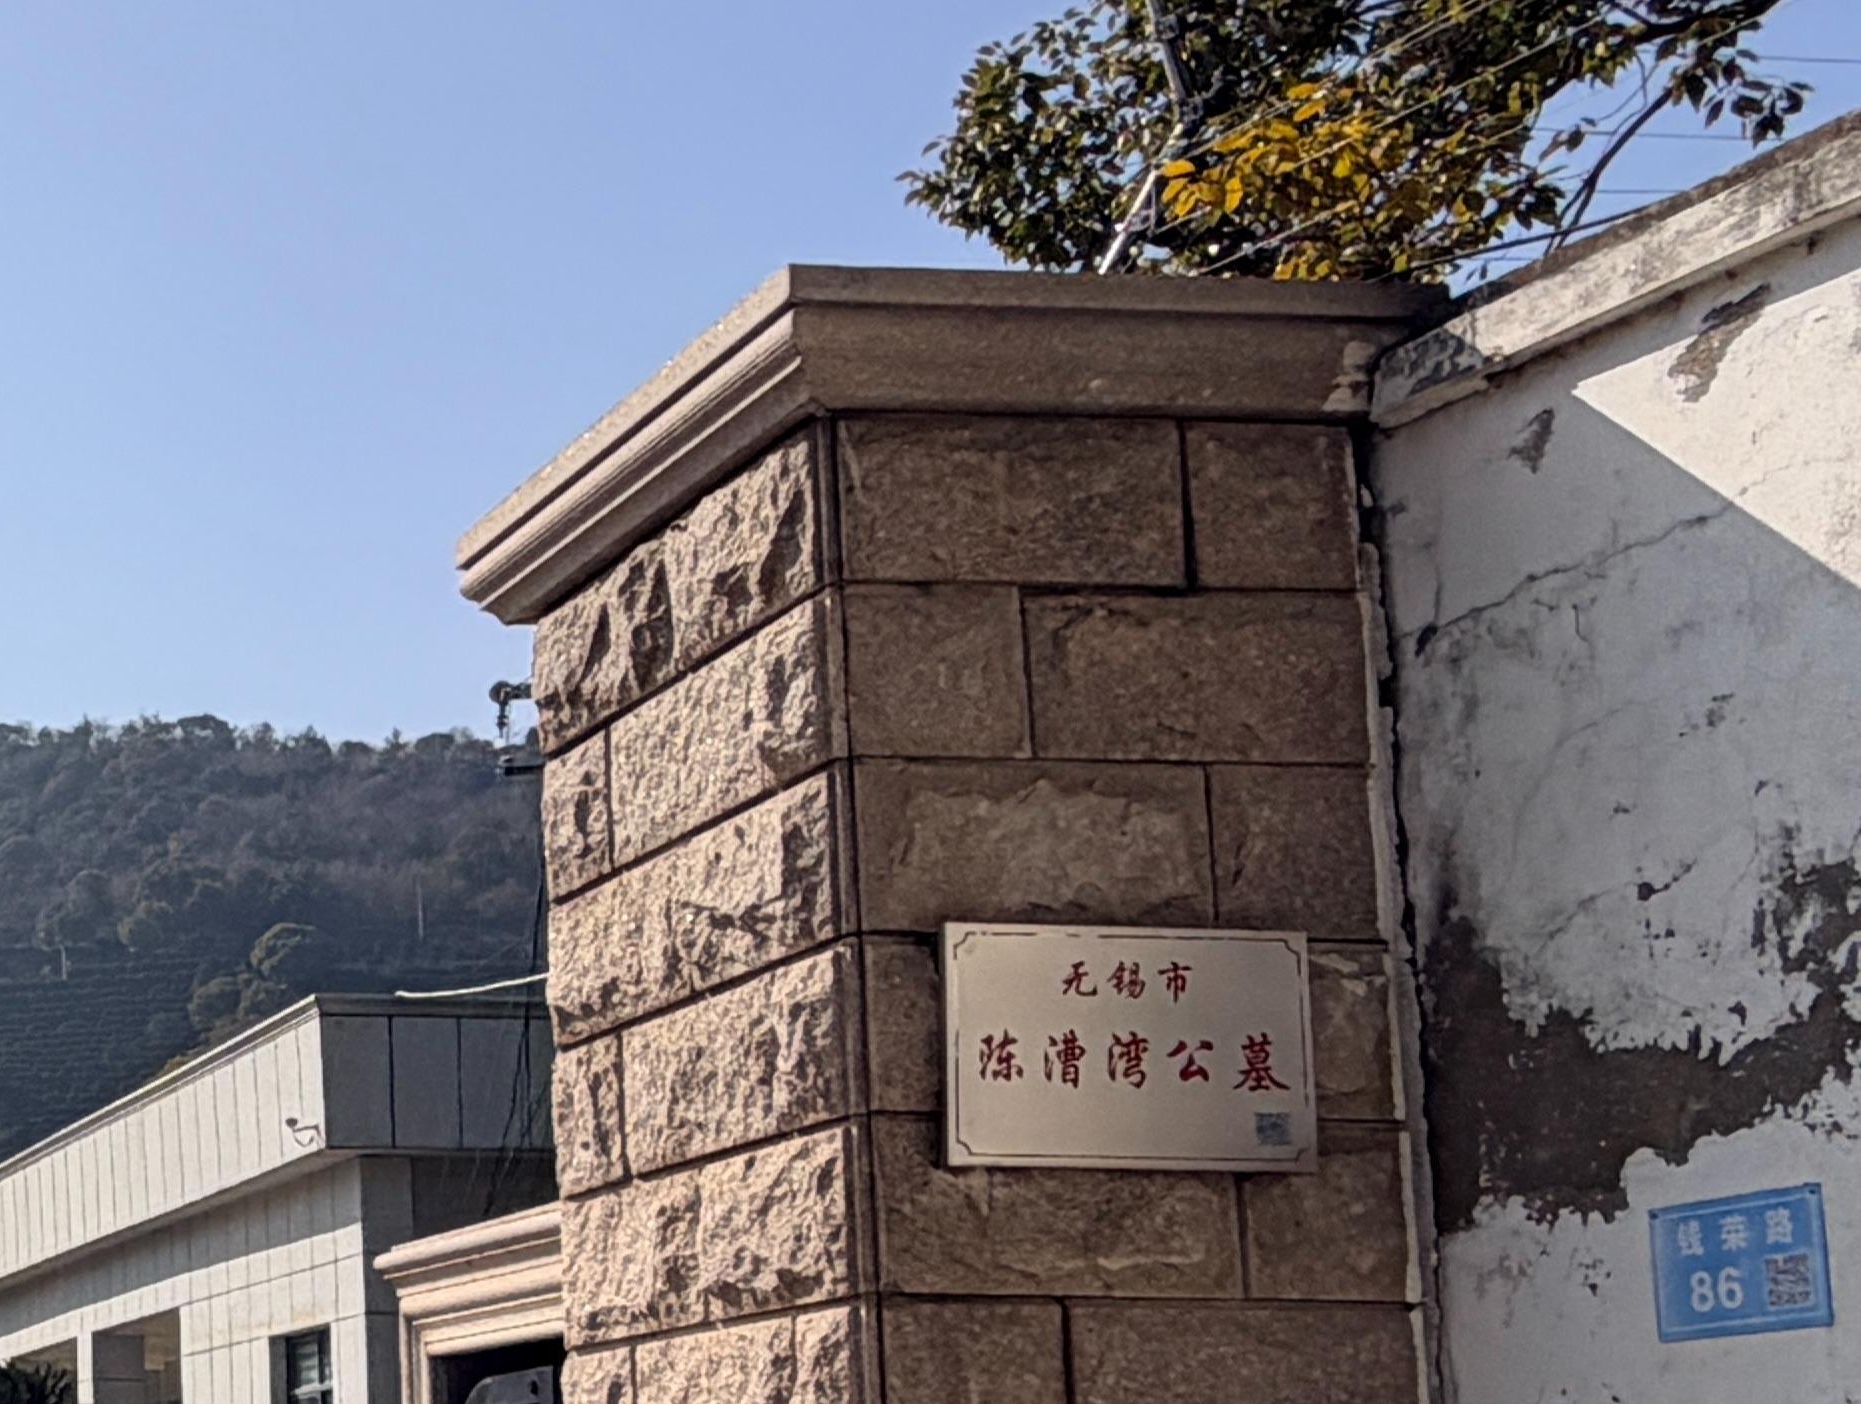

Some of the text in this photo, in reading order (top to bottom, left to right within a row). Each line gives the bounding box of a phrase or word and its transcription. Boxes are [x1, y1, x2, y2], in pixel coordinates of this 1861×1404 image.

[1061, 960, 1194, 1004] 无锡市
[978, 1028, 1291, 1092] 陈漕湾公墓
[1690, 1266, 1745, 1313] 86
